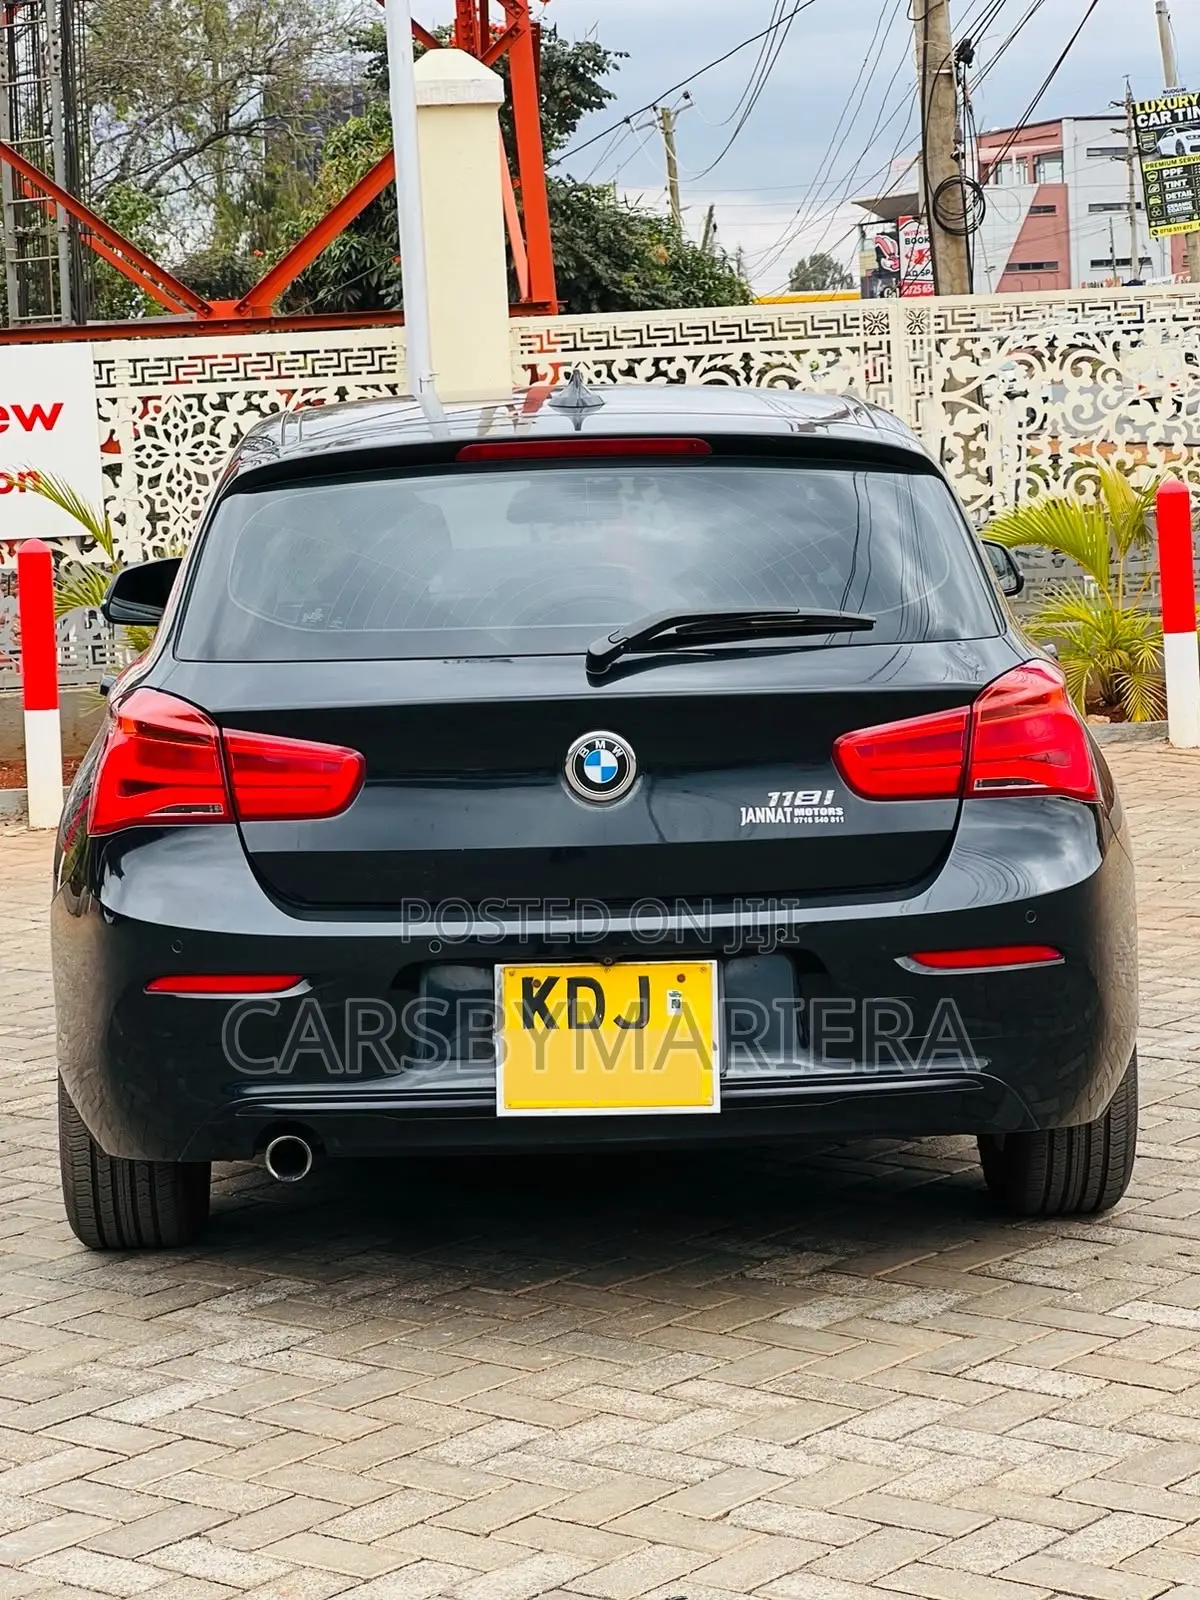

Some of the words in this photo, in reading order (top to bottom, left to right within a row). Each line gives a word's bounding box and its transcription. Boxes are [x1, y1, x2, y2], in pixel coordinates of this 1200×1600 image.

[1135, 93, 1199, 115] LUXURY
[1136, 110, 1172, 128] CAR
[1145, 160, 1177, 169] PREMIUM
[1162, 167, 1184, 177] PPF
[1164, 179, 1187, 189] TINT
[1165, 190, 1194, 200] DETAIL
[578, 740, 624, 759] BMW
[740, 807, 792, 827] JANNAT
[794, 807, 844, 816] MOTORS
[521, 975, 651, 1030] KDJ
